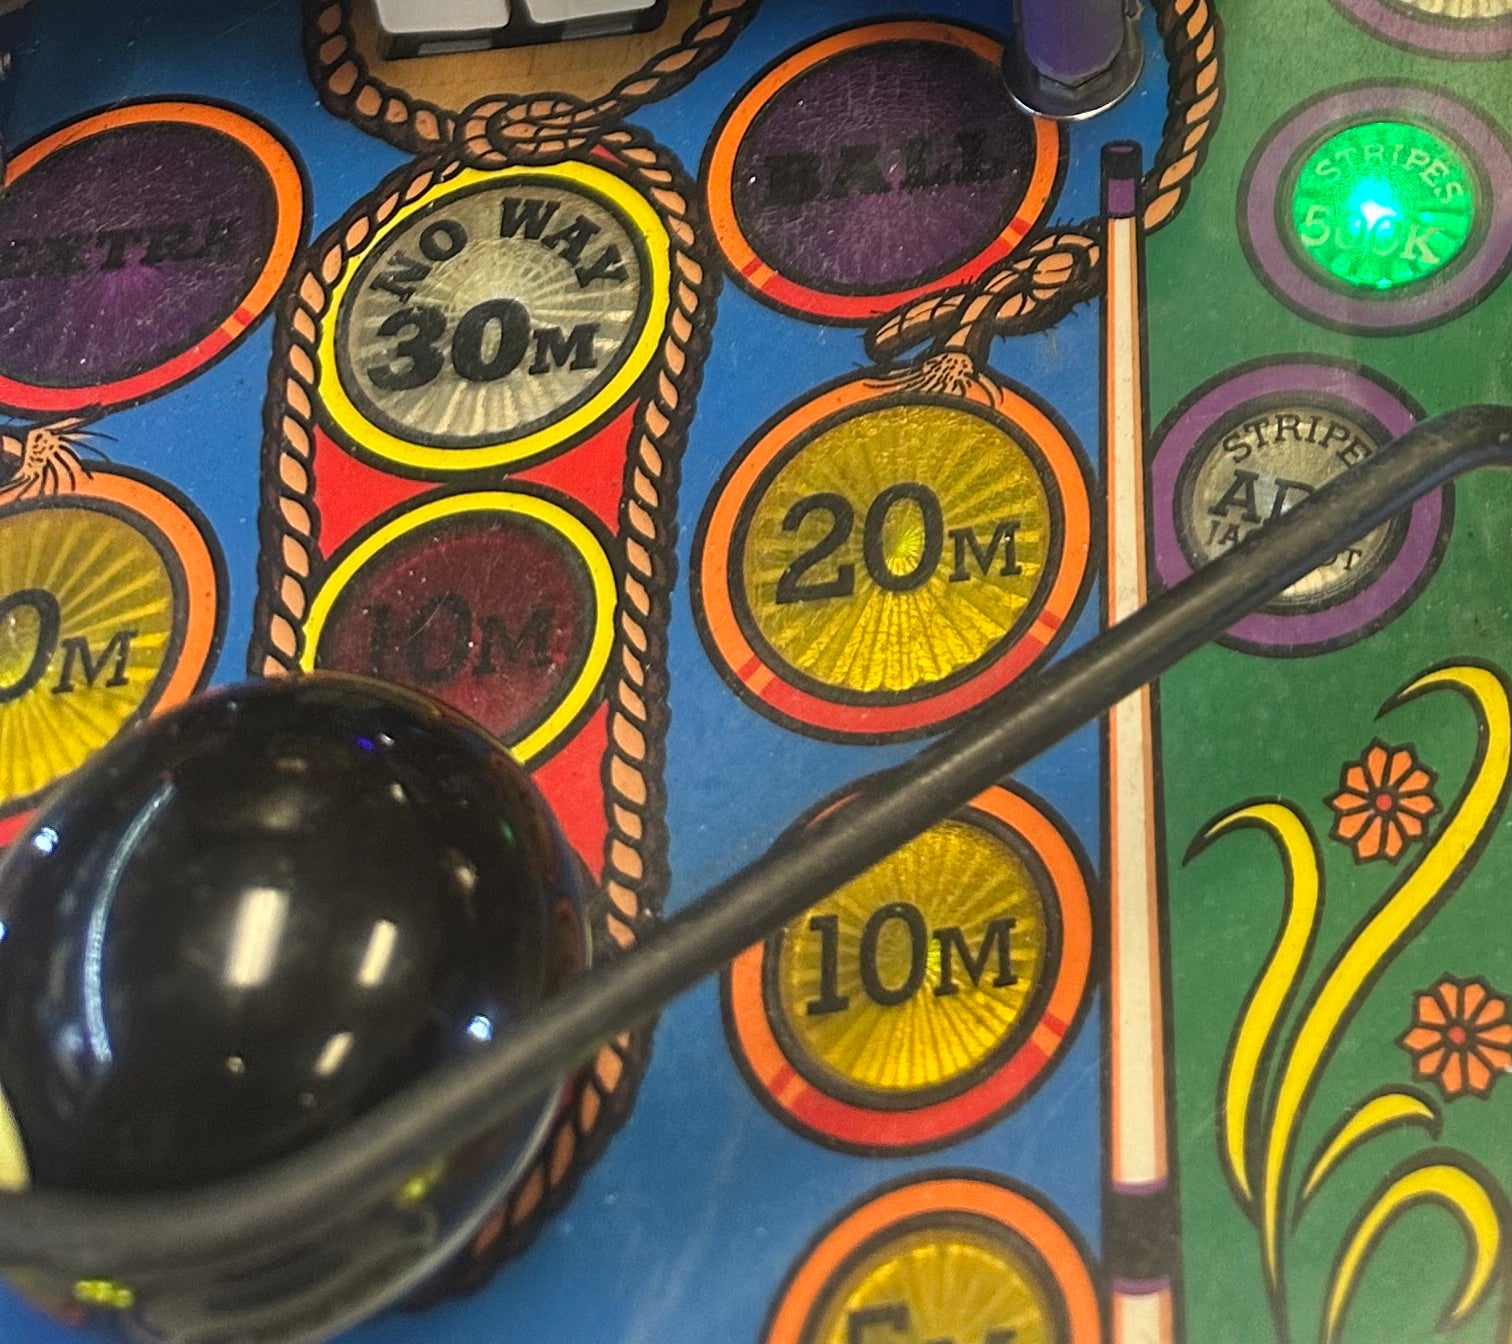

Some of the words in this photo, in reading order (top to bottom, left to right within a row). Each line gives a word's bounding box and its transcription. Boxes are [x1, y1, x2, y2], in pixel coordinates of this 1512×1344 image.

[1314, 143, 1466, 205] STRIPES
[369, 218, 468, 305] NO
[499, 196, 630, 289] WAY
[366, 297, 600, 391] 30M
[1222, 413, 1378, 469] STRIPE
[775, 481, 1024, 605] 20M
[368, 591, 556, 684] 10M
[805, 902, 1019, 1016] 10M
